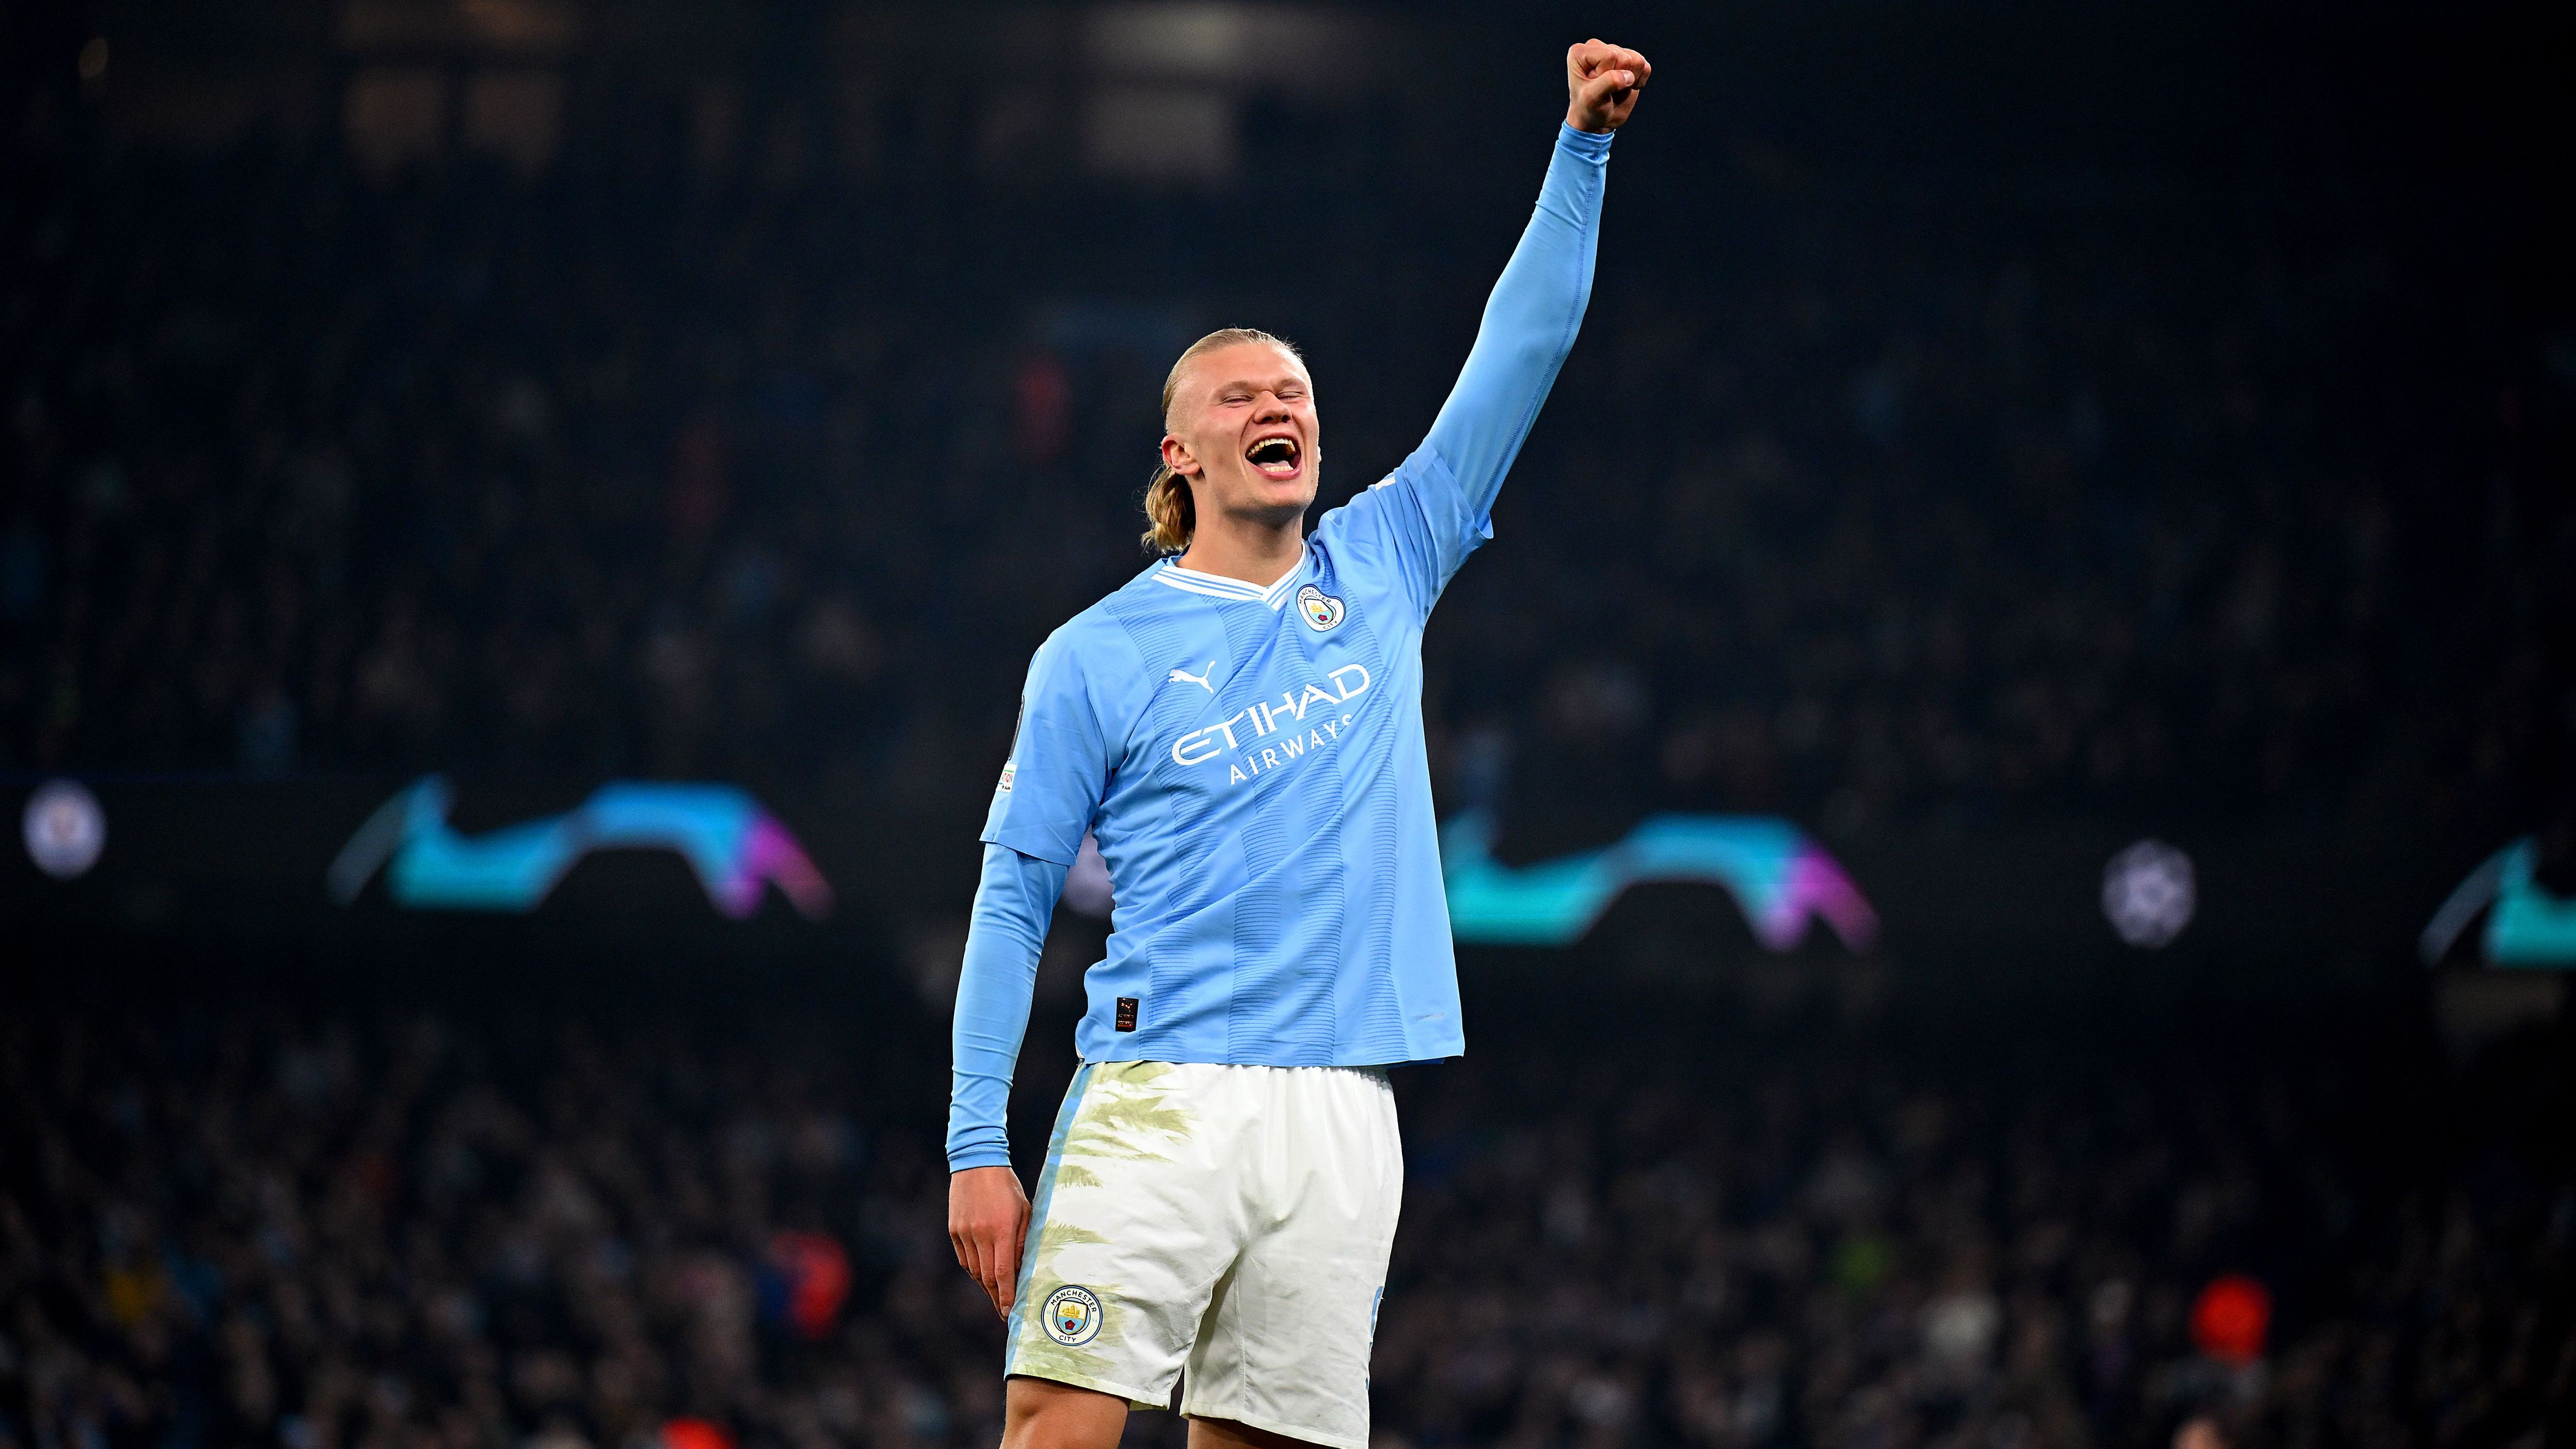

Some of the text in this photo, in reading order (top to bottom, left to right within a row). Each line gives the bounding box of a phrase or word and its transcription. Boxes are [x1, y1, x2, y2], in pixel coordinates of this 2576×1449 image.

[1299, 589, 1331, 604] MANCHESTER
[1323, 621, 1337, 629] CITY
[1172, 664, 1370, 766] ETIHAD
[1051, 1290, 1096, 1312] MANCHESTER
